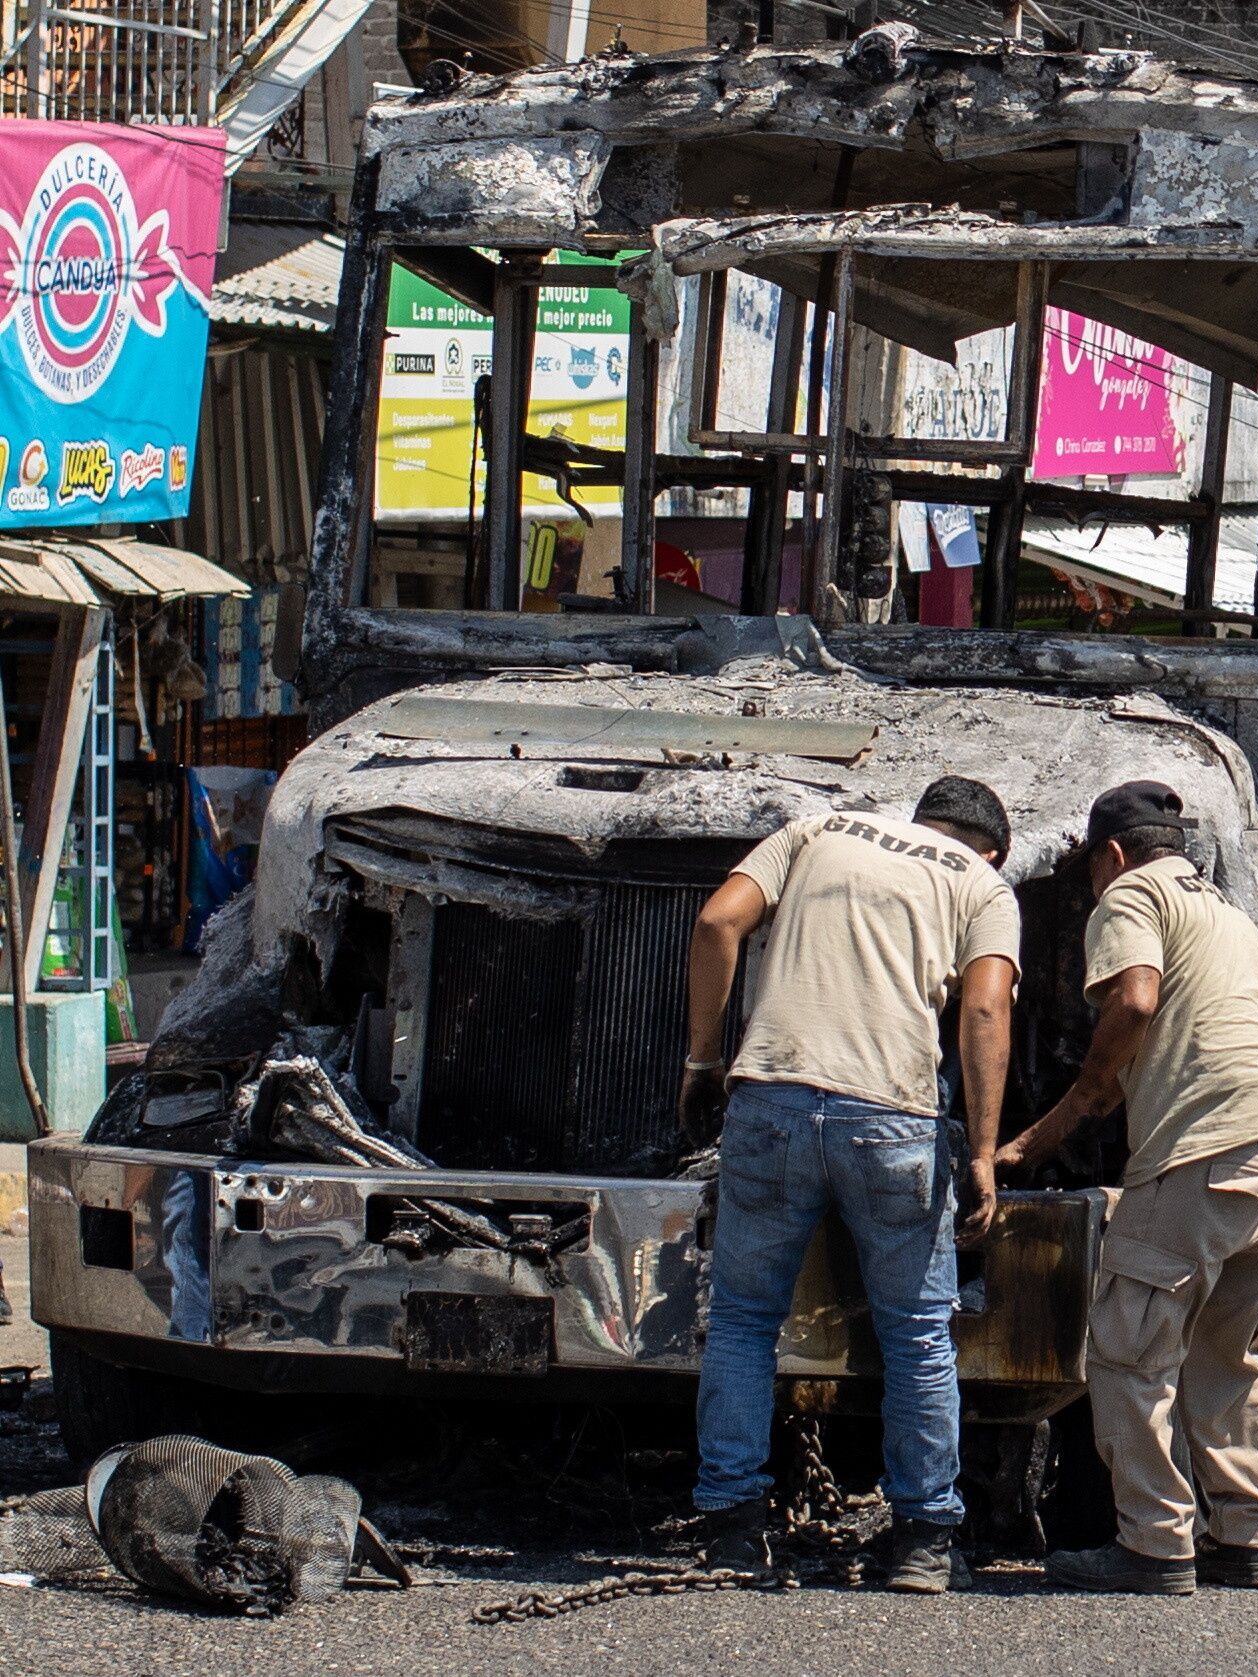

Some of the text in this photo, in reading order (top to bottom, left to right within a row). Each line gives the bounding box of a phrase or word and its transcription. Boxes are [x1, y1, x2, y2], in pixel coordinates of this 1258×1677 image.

[40, 155, 122, 213] DULCERÍA
[37, 257, 117, 292] CANDYA
[538, 286, 589, 303] ENUDEO
[412, 302, 613, 330] Las mejores mejor precio
[396, 356, 434, 372] PURINA
[75, 371, 81, 390] Y
[60, 446, 113, 498] LUCAS
[121, 449, 163, 488] Ricolino
[10, 492, 48, 506] GONAC
[821, 815, 971, 872] GRUAS
